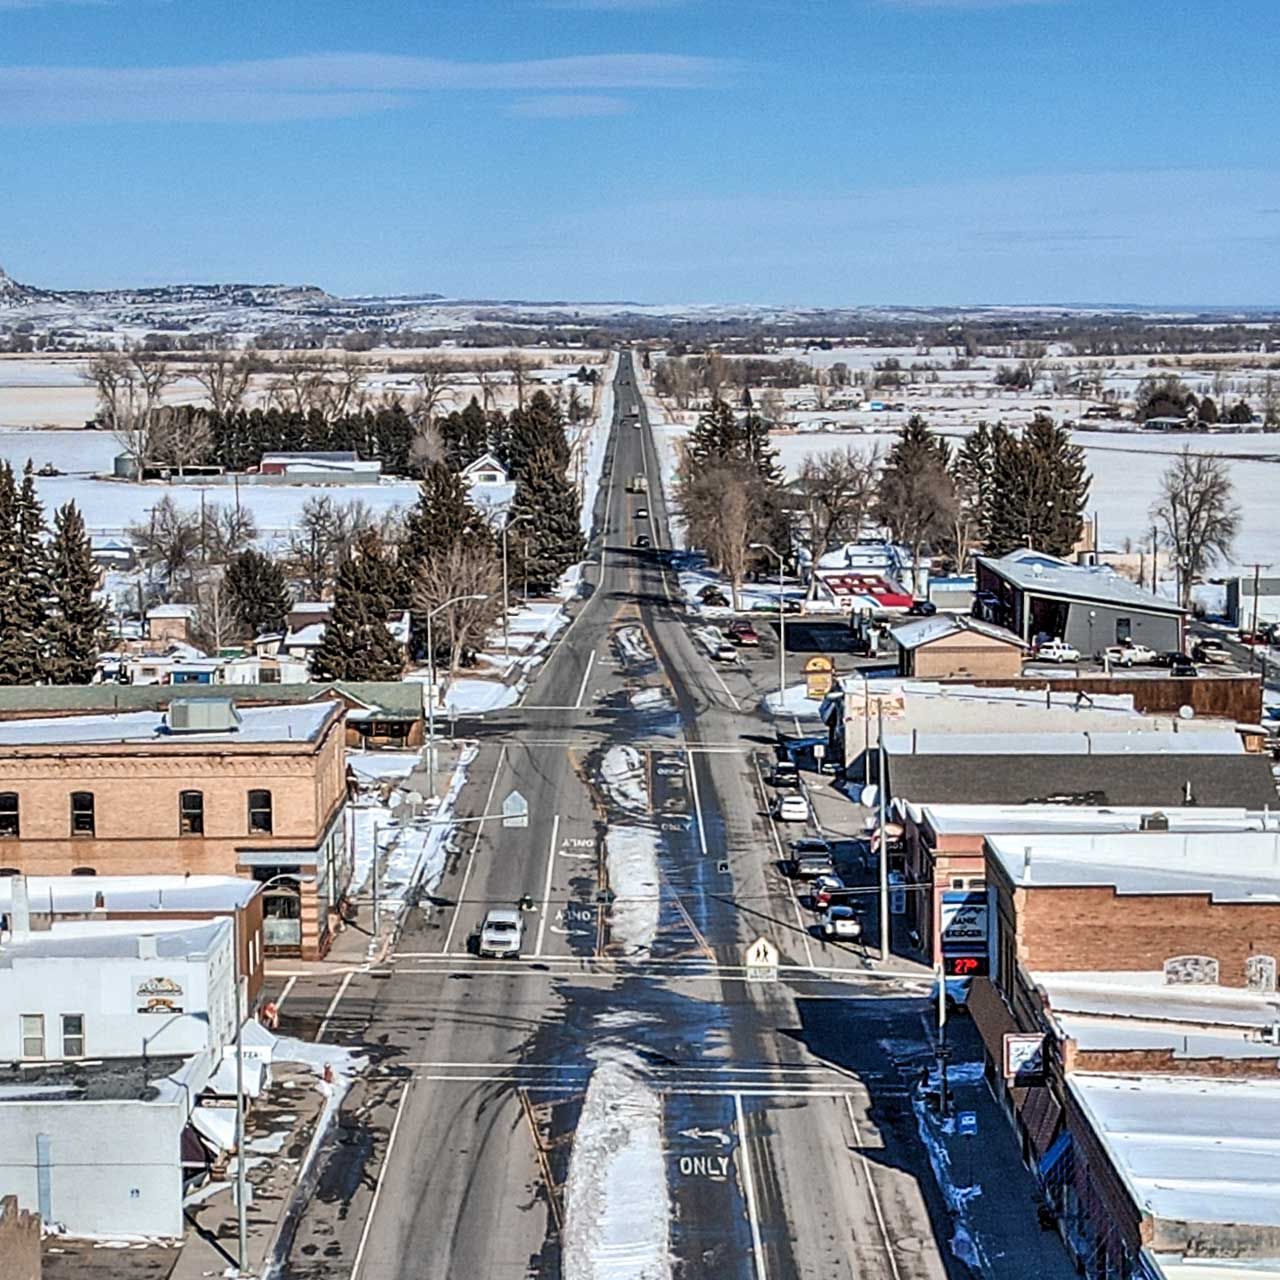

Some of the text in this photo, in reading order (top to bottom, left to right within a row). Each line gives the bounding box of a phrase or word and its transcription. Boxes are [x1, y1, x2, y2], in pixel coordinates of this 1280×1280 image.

[561, 839, 595, 848] ONLY
[554, 910, 592, 921] ONLY
[679, 1155, 731, 1177] ONLY
